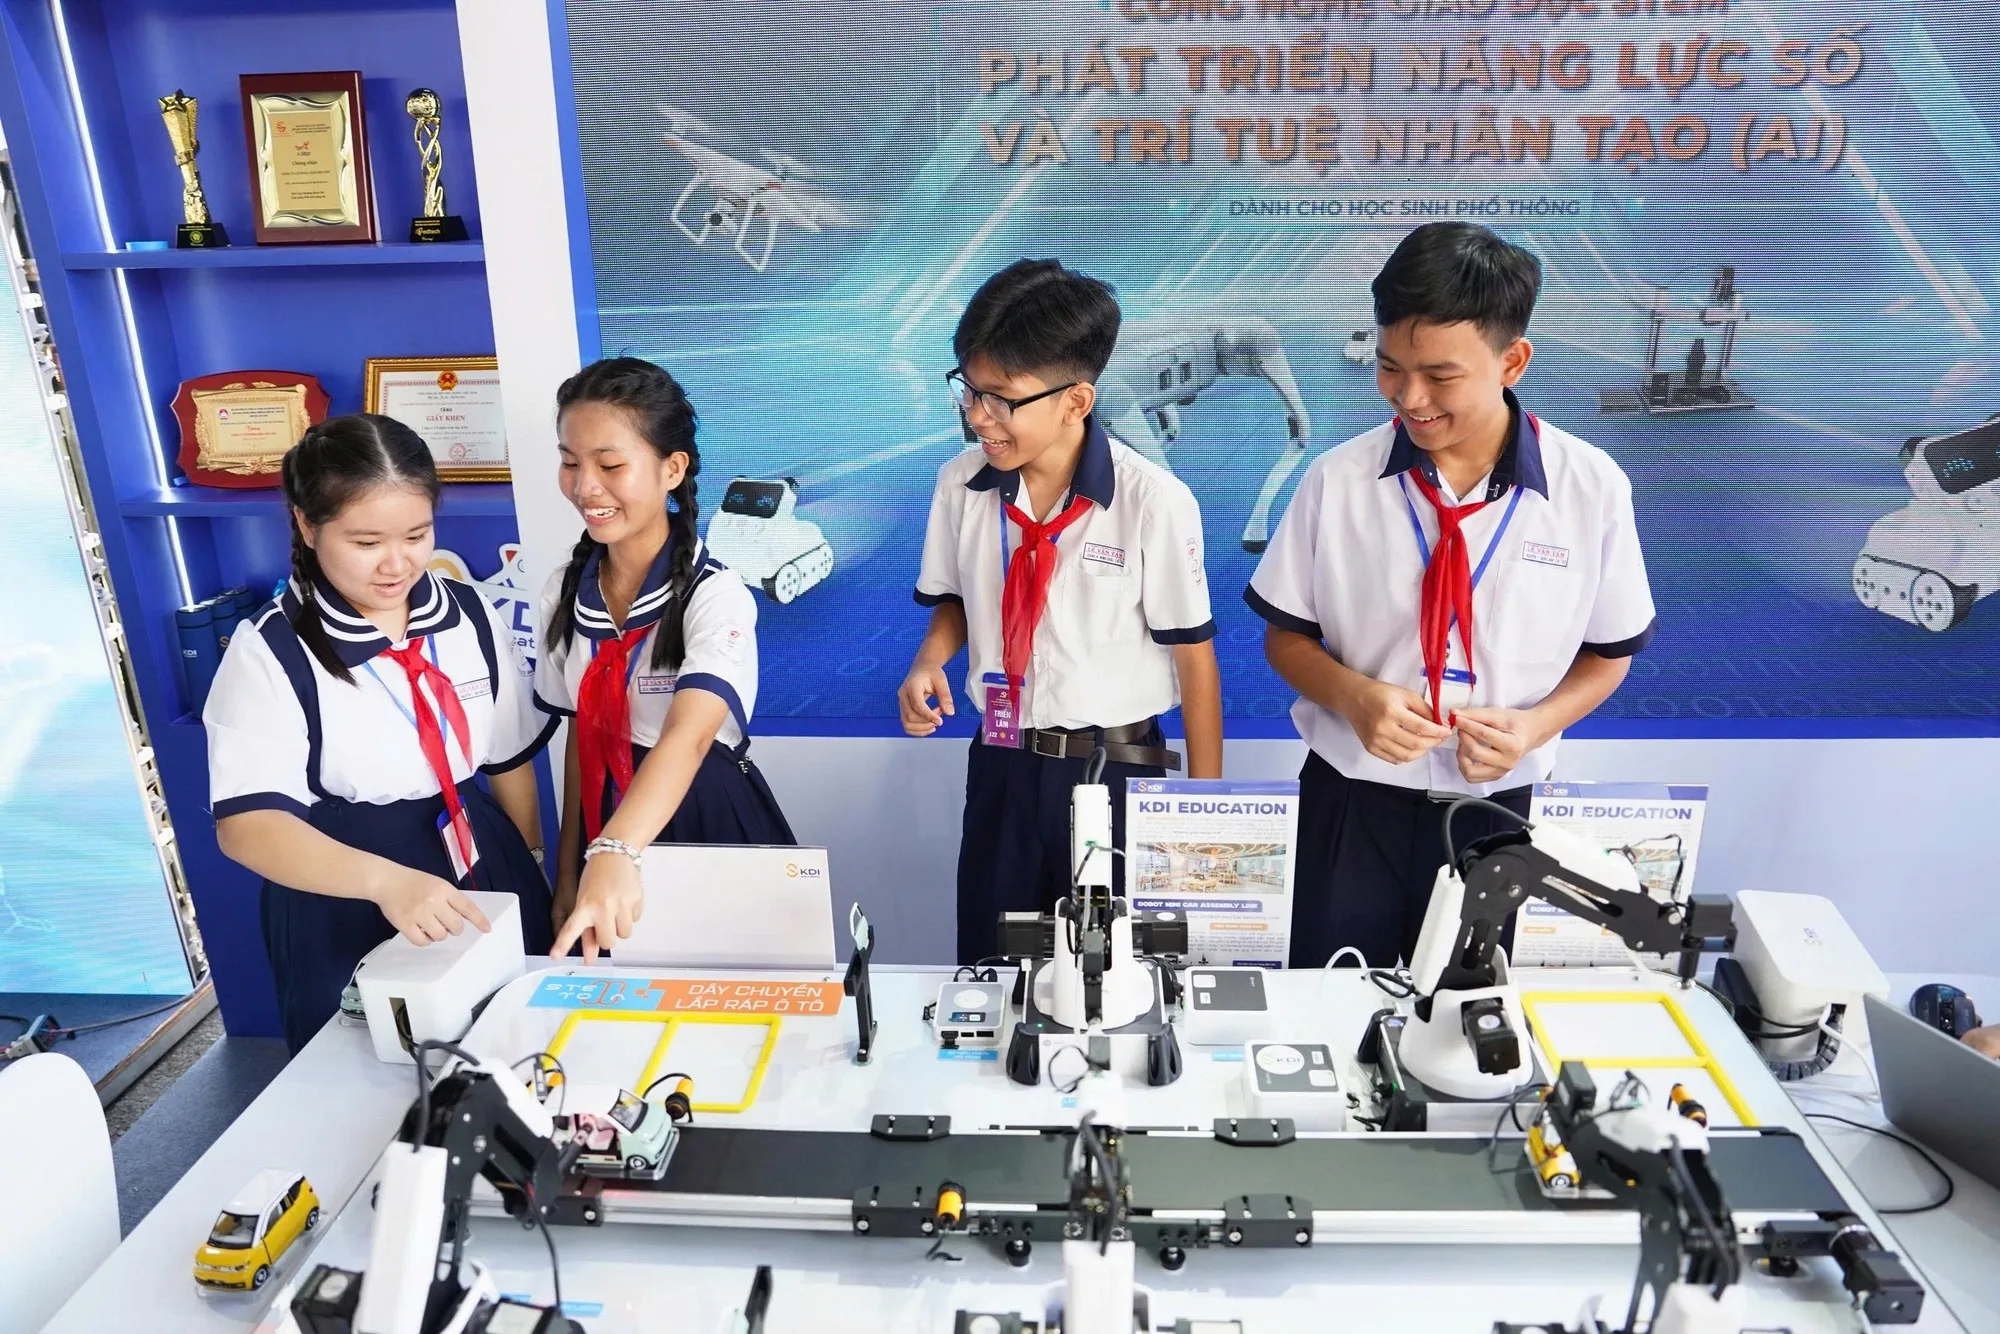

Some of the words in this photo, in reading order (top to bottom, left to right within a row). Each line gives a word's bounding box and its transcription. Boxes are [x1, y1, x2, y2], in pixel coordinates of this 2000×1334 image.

[980, 36, 1156, 93] PHÁT
[1401, 32, 1591, 89] NĂNG
[1618, 34, 1749, 97] LỰC
[1773, 22, 1871, 87] SỐ
[980, 108, 1068, 163] VÀ
[1095, 106, 1194, 162] TRÍ
[1217, 104, 1342, 174] TUỆ
[1363, 105, 1555, 163] NHÂN
[1578, 115, 1710, 173] TẠO
[1732, 111, 1847, 172] (AI)
[1229, 198, 1290, 216] DÀNH
[1298, 200, 1343, 216] CHO
[1348, 200, 1393, 220] HỌC
[1400, 200, 1449, 216] SINH
[1456, 195, 1501, 216] PHỔ
[1507, 196, 1580, 216] THÔNG
[1139, 801, 1170, 813] KDI
[1178, 802, 1287, 815] EDUCATION
[1542, 805, 1574, 817] KDI
[1582, 806, 1692, 820] EDUCATION
[688, 982, 732, 995] DÂY
[723, 997, 768, 1011] RÁP
[774, 999, 789, 1011] Ô
[797, 999, 824, 1012] TÔ
